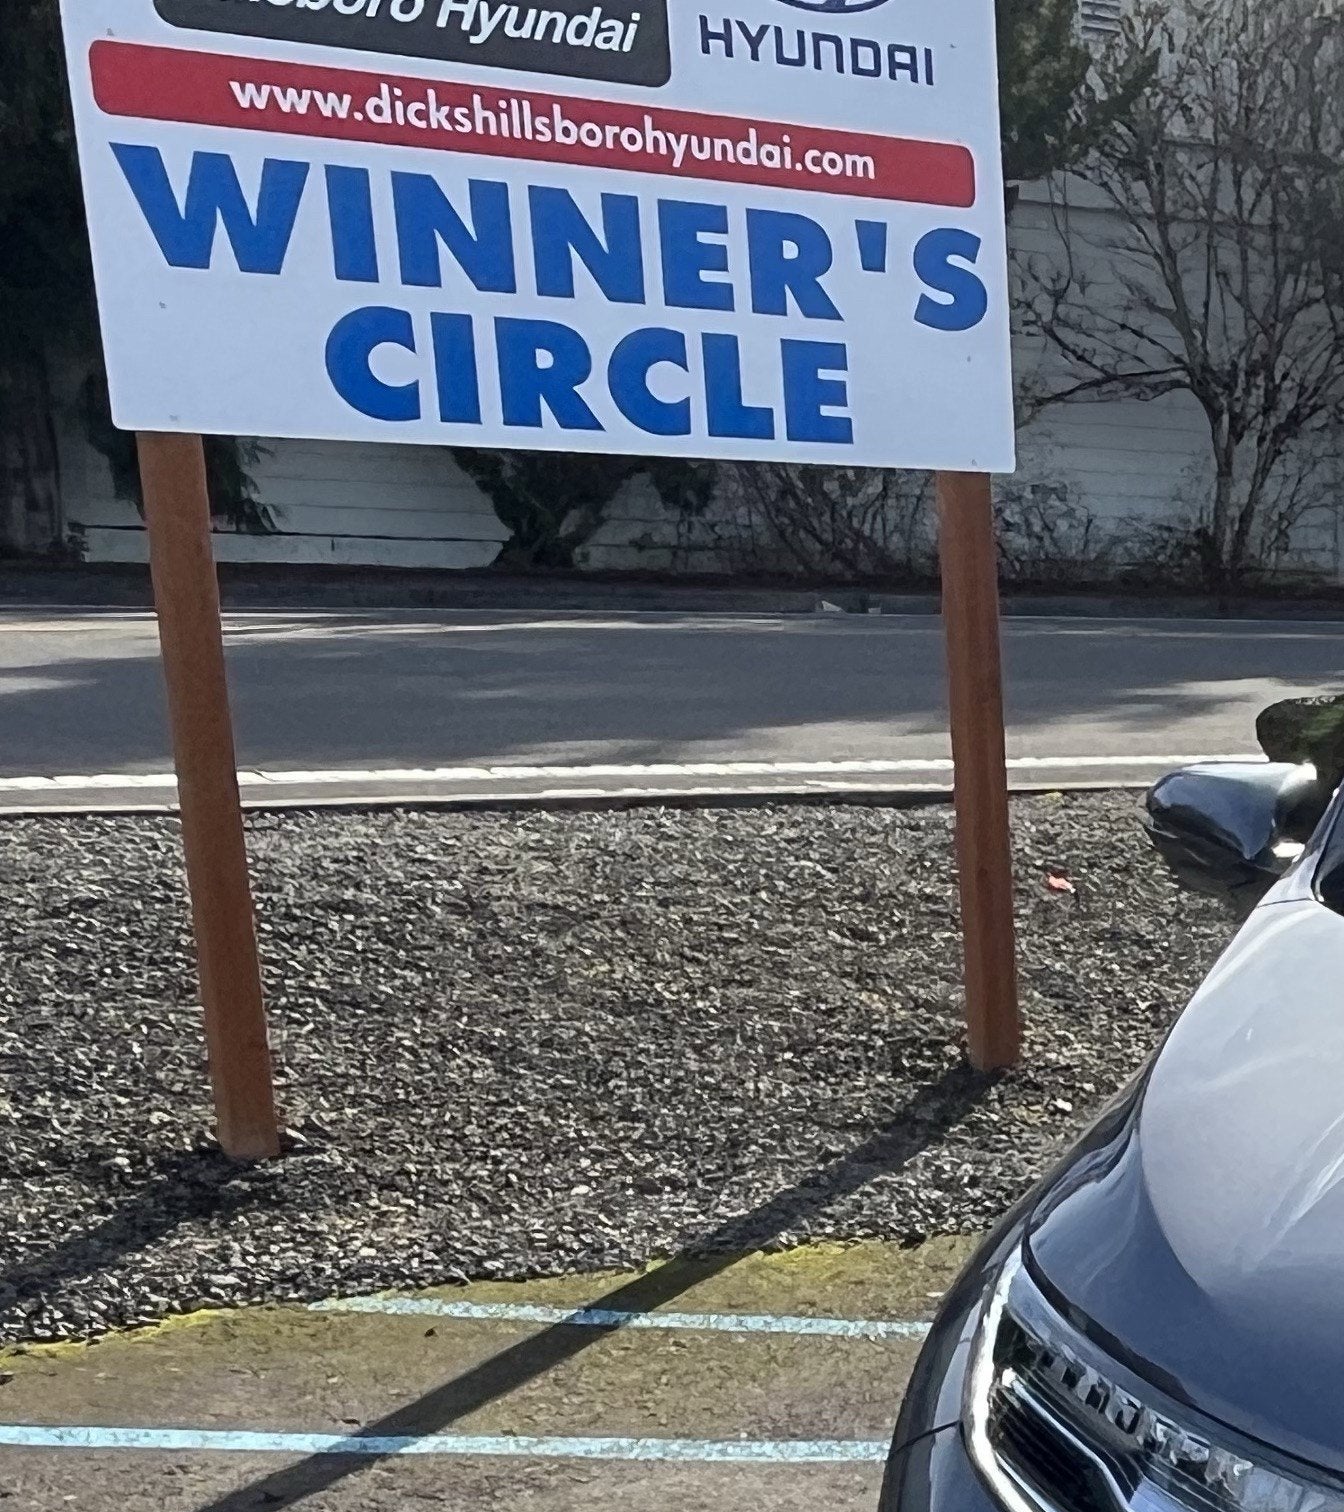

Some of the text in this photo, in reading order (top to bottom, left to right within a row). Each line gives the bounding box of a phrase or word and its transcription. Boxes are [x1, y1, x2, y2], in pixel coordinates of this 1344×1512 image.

[436, 0, 639, 53] Hyundai
[699, 14, 934, 86] HYUNDAI
[229, 80, 875, 180] www.dickshillsborohyundai.com
[110, 142, 988, 331] WINNER'S
[325, 306, 854, 444] CIRCLE
